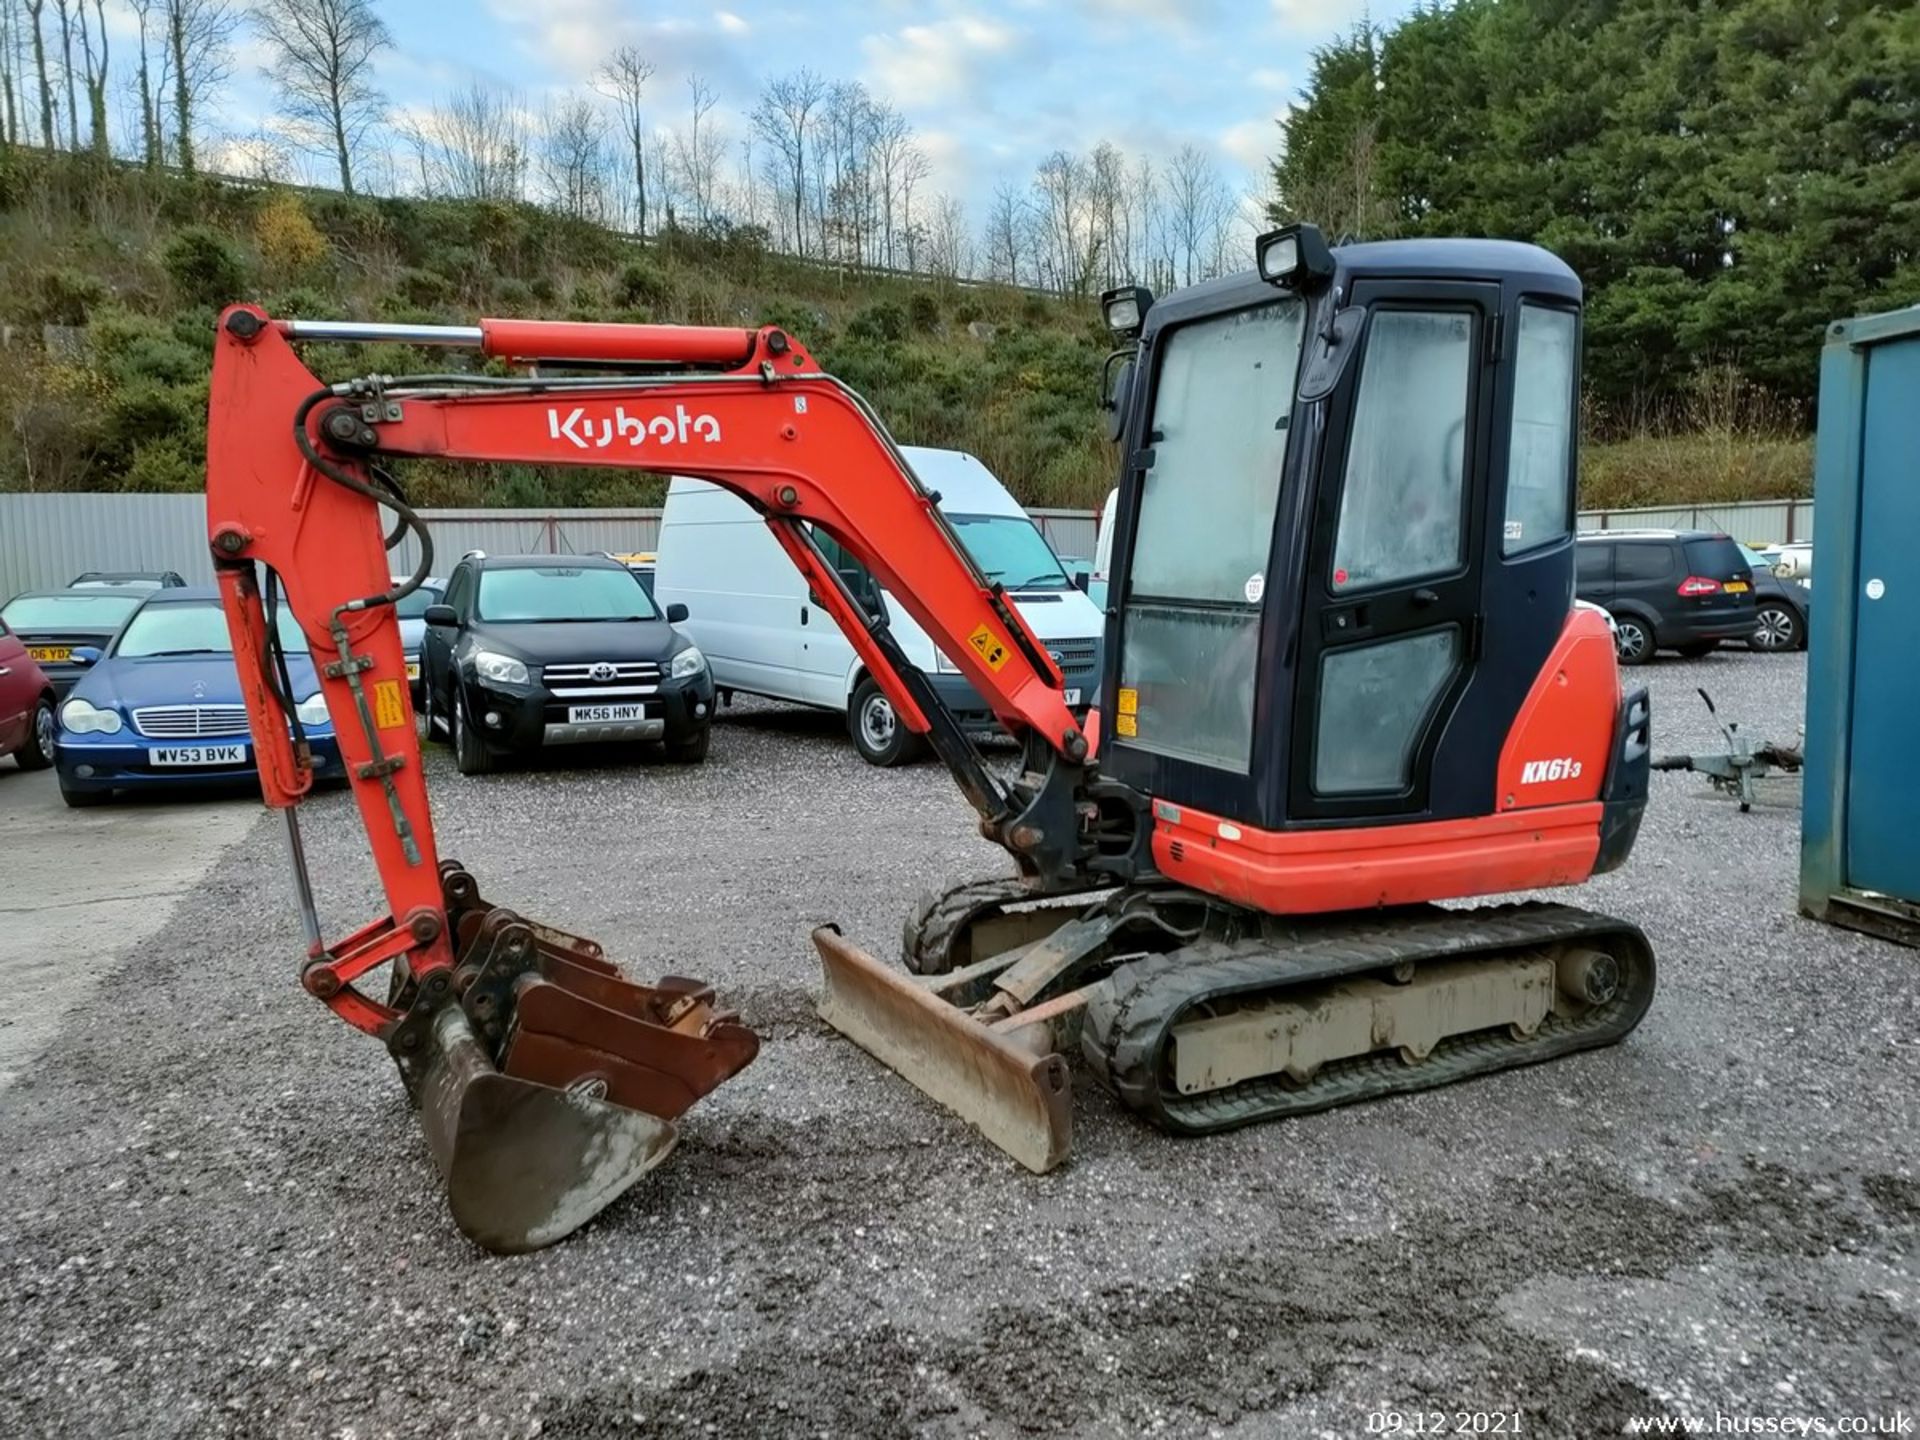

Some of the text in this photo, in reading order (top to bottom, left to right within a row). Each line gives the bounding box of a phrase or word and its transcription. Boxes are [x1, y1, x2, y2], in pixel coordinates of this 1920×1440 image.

[548, 404, 721, 449] Kubota
[575, 706, 639, 721] MK56 HNY
[157, 747, 238, 762] WV53 BVK
